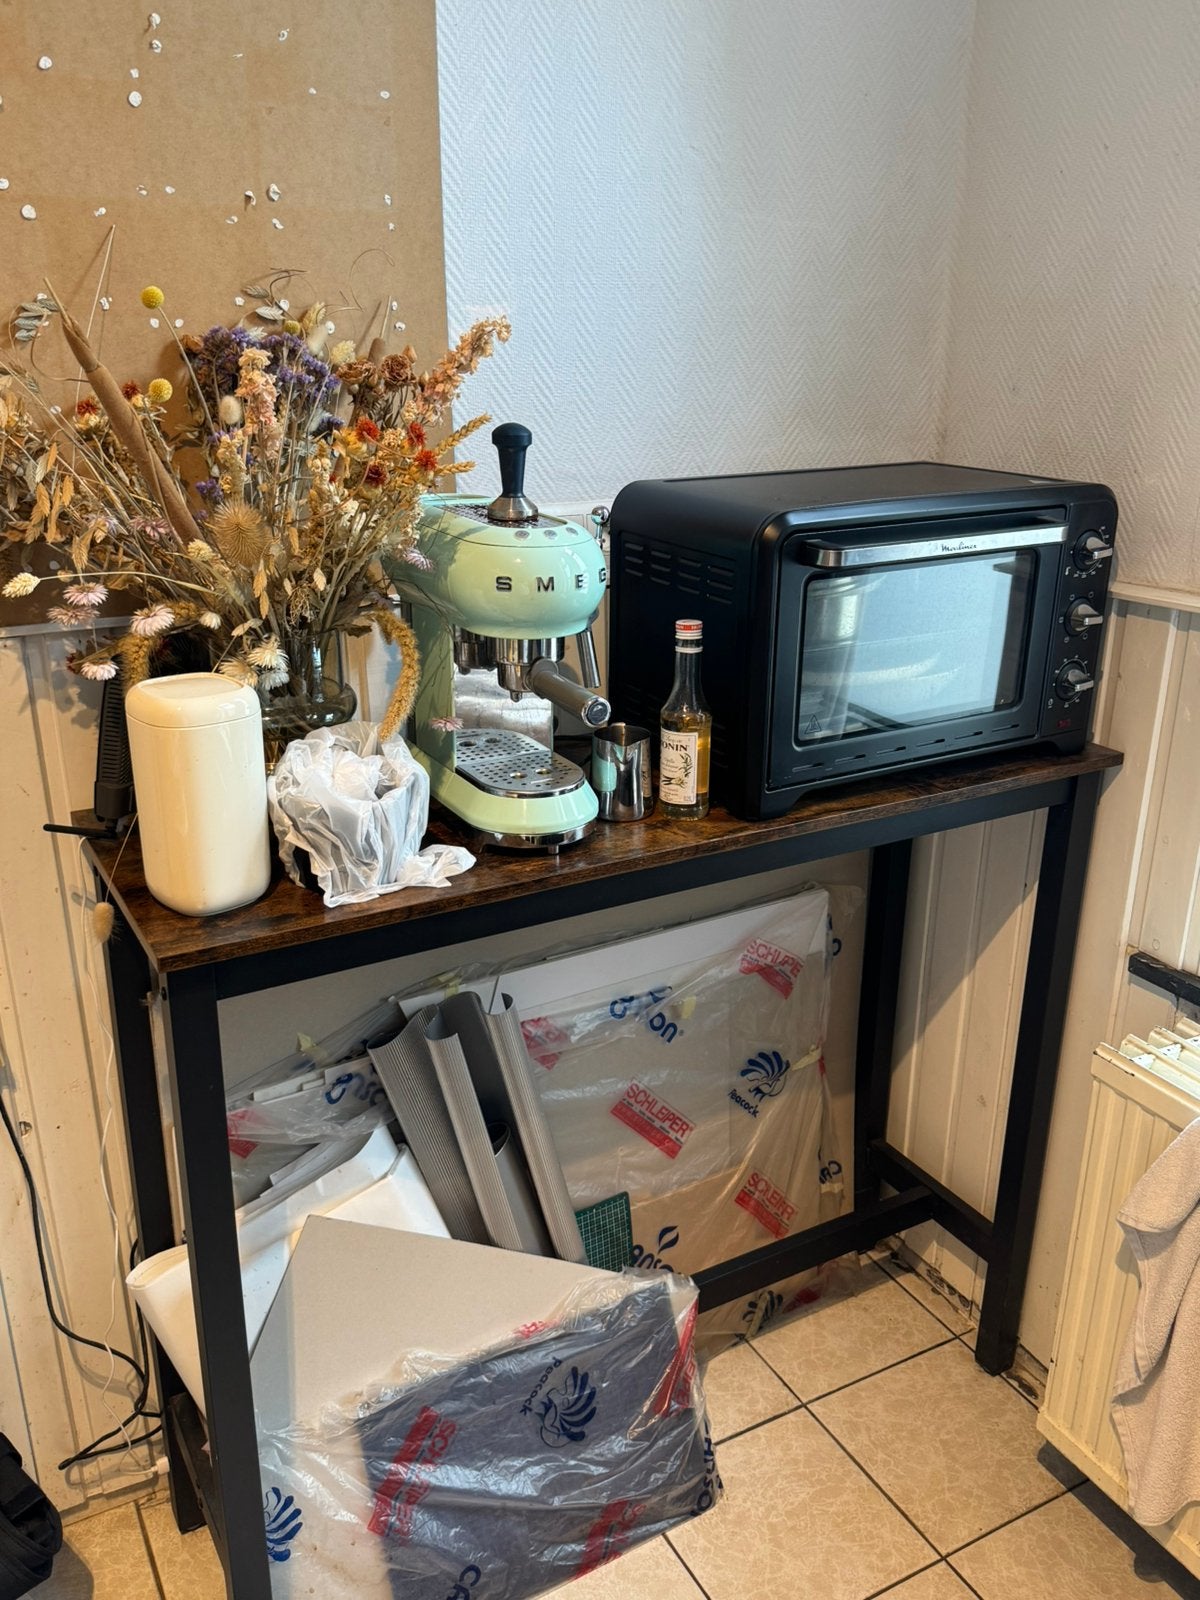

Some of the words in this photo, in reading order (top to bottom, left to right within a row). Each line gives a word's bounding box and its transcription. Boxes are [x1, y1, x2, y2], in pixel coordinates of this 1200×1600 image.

[495, 566, 607, 592] SMEG
[661, 741, 689, 752] ONIN
[626, 1082, 692, 1138] SCHLEIPER
